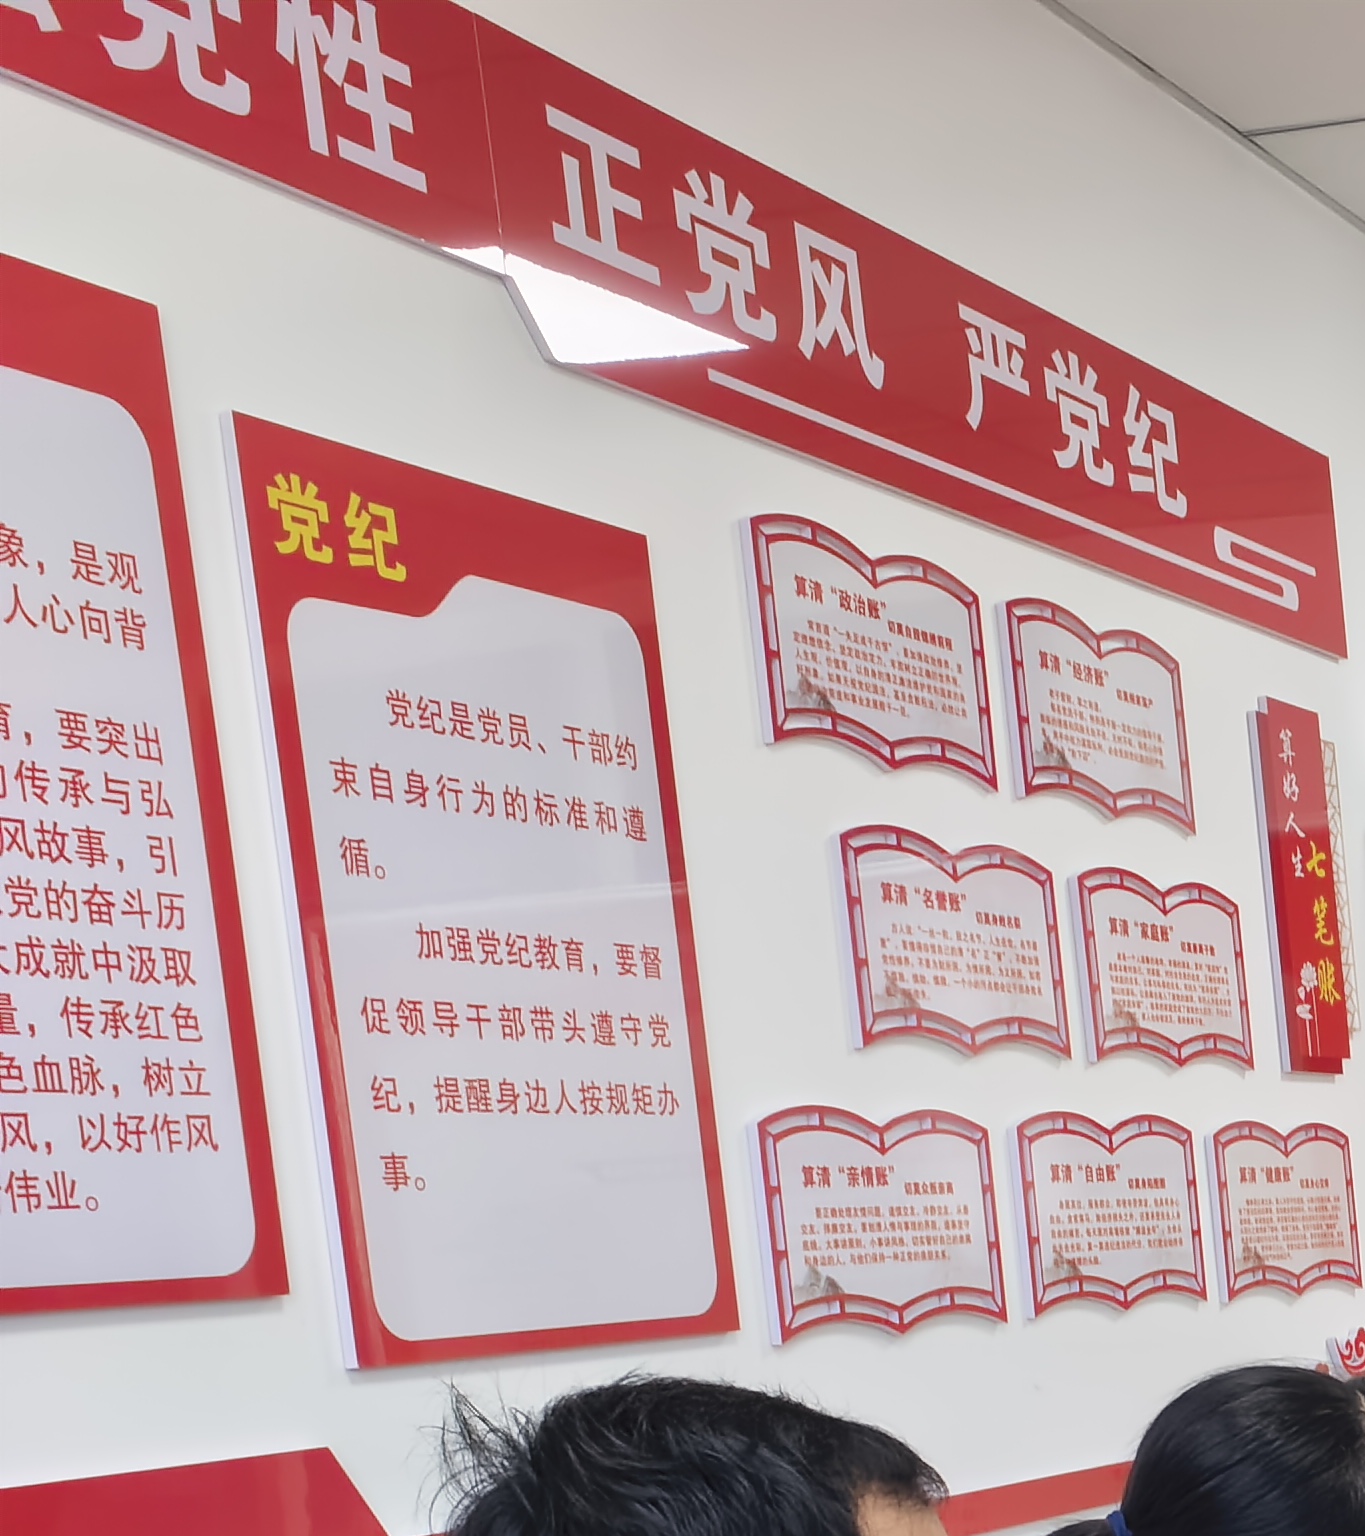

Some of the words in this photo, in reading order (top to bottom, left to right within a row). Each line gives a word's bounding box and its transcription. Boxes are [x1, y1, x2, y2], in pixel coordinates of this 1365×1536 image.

[0, 0, 427, 193] 党性
[545, 103, 885, 390] 正党风
[957, 302, 1188, 519] 严党纪
[266, 473, 407, 582] 党纪
[3, 583, 148, 652] 人心向背
[385, 688, 638, 771] 党纪是党员、干部约
[0, 759, 174, 819] 传承与弘
[330, 755, 649, 842] 束自身行为的标准和遵
[1278, 728, 1306, 879] 算好人生
[340, 836, 387, 880] 循。
[0, 876, 187, 932] 党的奋斗历
[1306, 840, 1342, 1005] 七笔账
[415, 922, 663, 981] 加强党纪教育，要督
[361, 995, 672, 1049] 促领导干部带头遵守党
[371, 1075, 680, 1119] 纪，提醒身边人按规矩办
[0, 1170, 100, 1214] 伟业。
[380, 1152, 426, 1192] 事。
